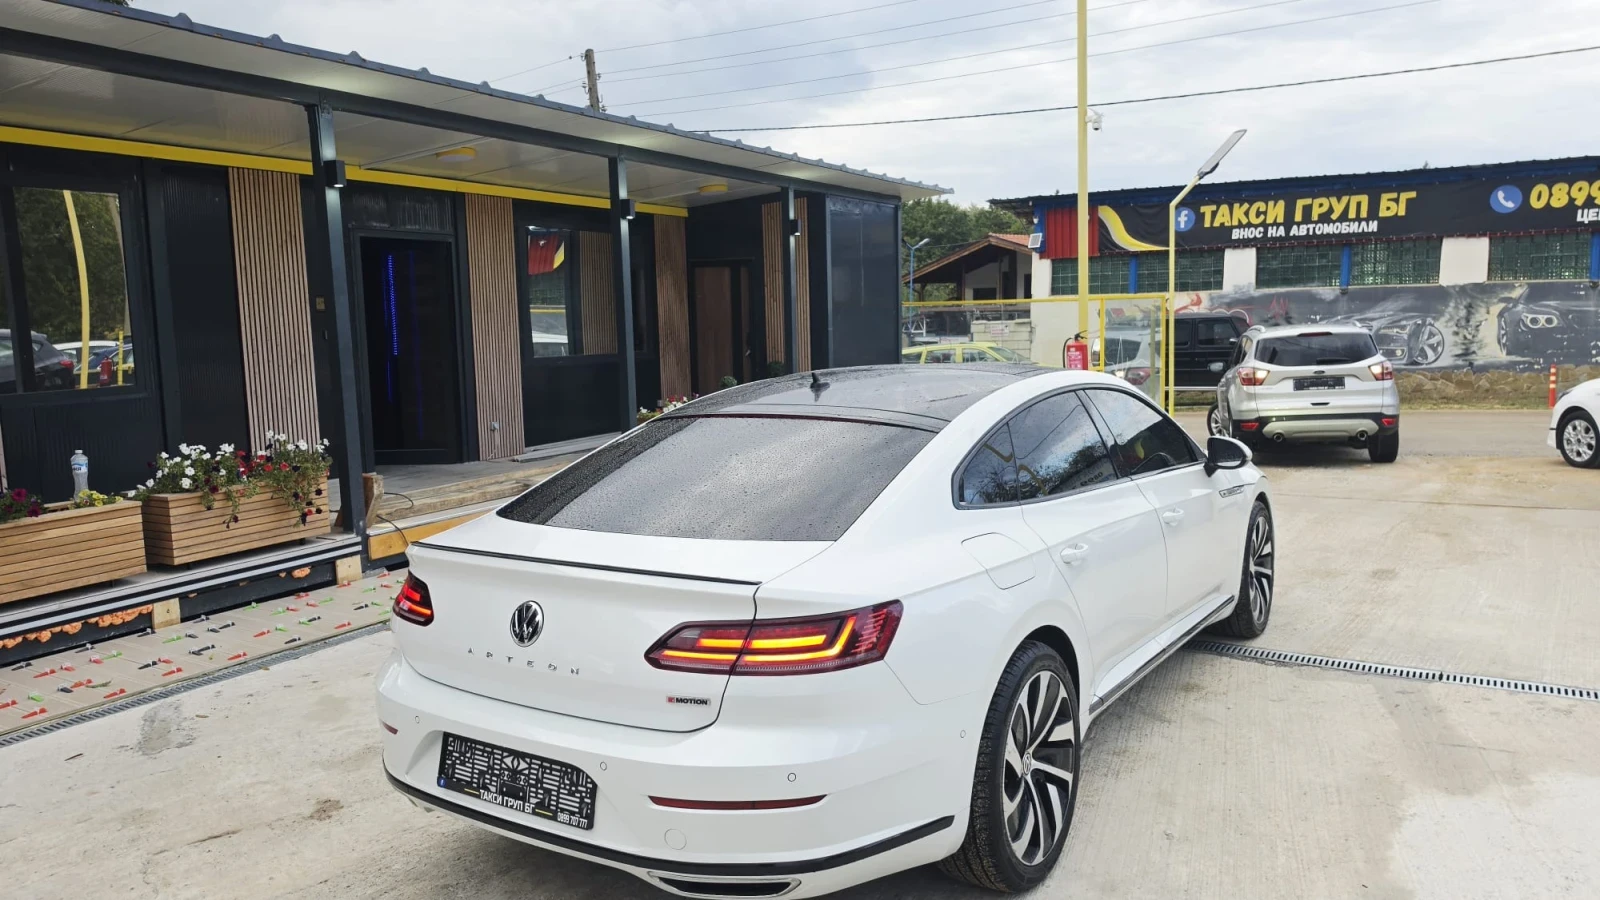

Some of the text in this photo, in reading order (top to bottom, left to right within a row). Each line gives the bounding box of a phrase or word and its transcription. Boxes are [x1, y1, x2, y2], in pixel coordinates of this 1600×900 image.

[1200, 191, 1417, 228] ТАКСИ ГРУП БГ
[1576, 208, 1600, 224] ЦЕ
[1231, 220, 1379, 240] ВНОС НА АВТОМОБИЛИ
[467, 647, 580, 676] ARTEON
[479, 789, 536, 814] ТАКСИ ГРУП БГ
[557, 812, 570, 824] 0899
[570, 815, 579, 826] 707
